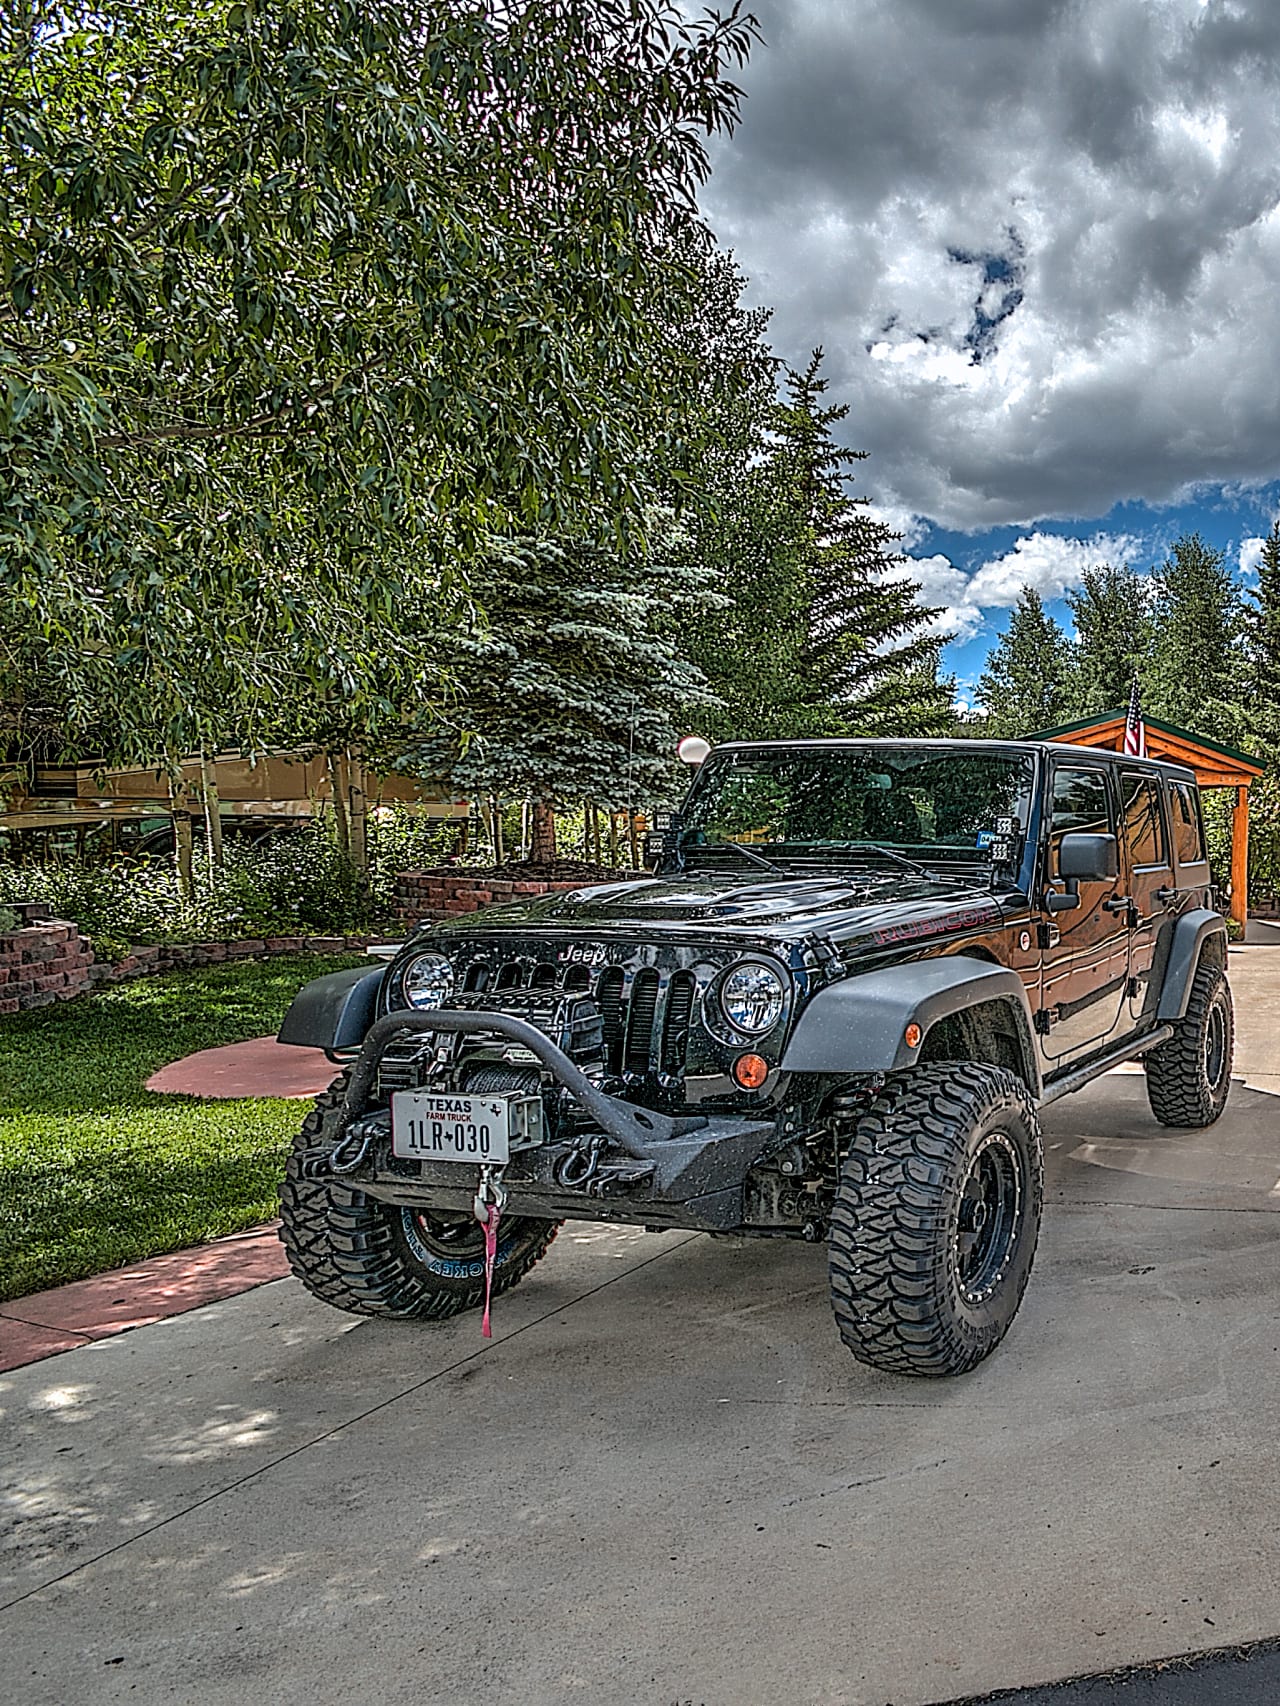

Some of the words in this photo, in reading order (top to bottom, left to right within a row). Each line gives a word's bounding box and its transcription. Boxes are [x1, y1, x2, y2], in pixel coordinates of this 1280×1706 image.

[872, 906, 994, 944] RUBICON
[558, 945, 605, 965] Jeep
[427, 1099, 472, 1113] TEXAS
[426, 1112, 445, 1120] FARM
[448, 1113, 472, 1122] TRUCK
